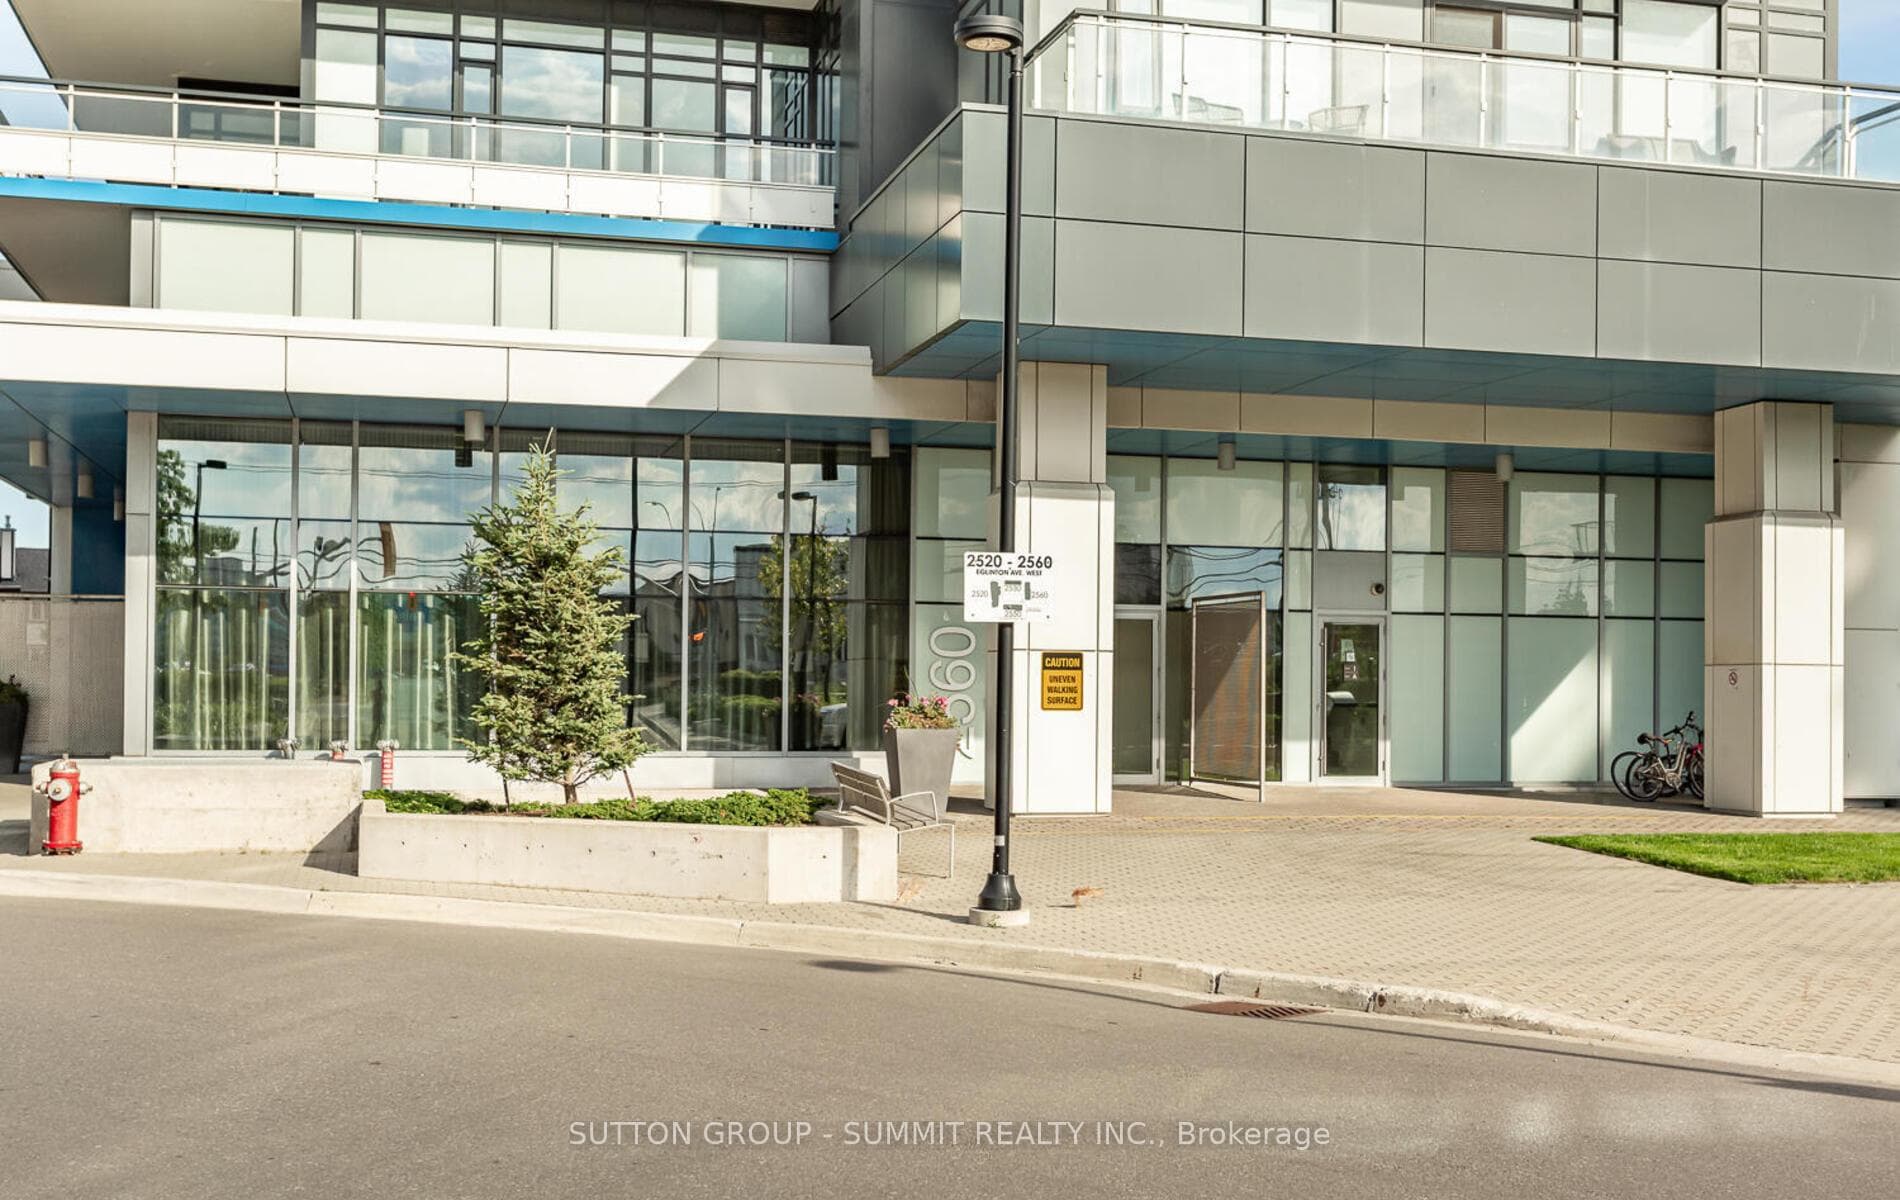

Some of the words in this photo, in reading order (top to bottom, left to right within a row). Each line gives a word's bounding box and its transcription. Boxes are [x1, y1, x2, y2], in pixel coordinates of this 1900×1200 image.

[967, 554, 1002, 568] 2520
[1017, 555, 1053, 569] 2560
[1045, 657, 1080, 667] CAUTION
[1048, 675, 1077, 683] UNEVEN
[1047, 686, 1078, 694] WALKING
[1047, 696, 1077, 704] SURFACE
